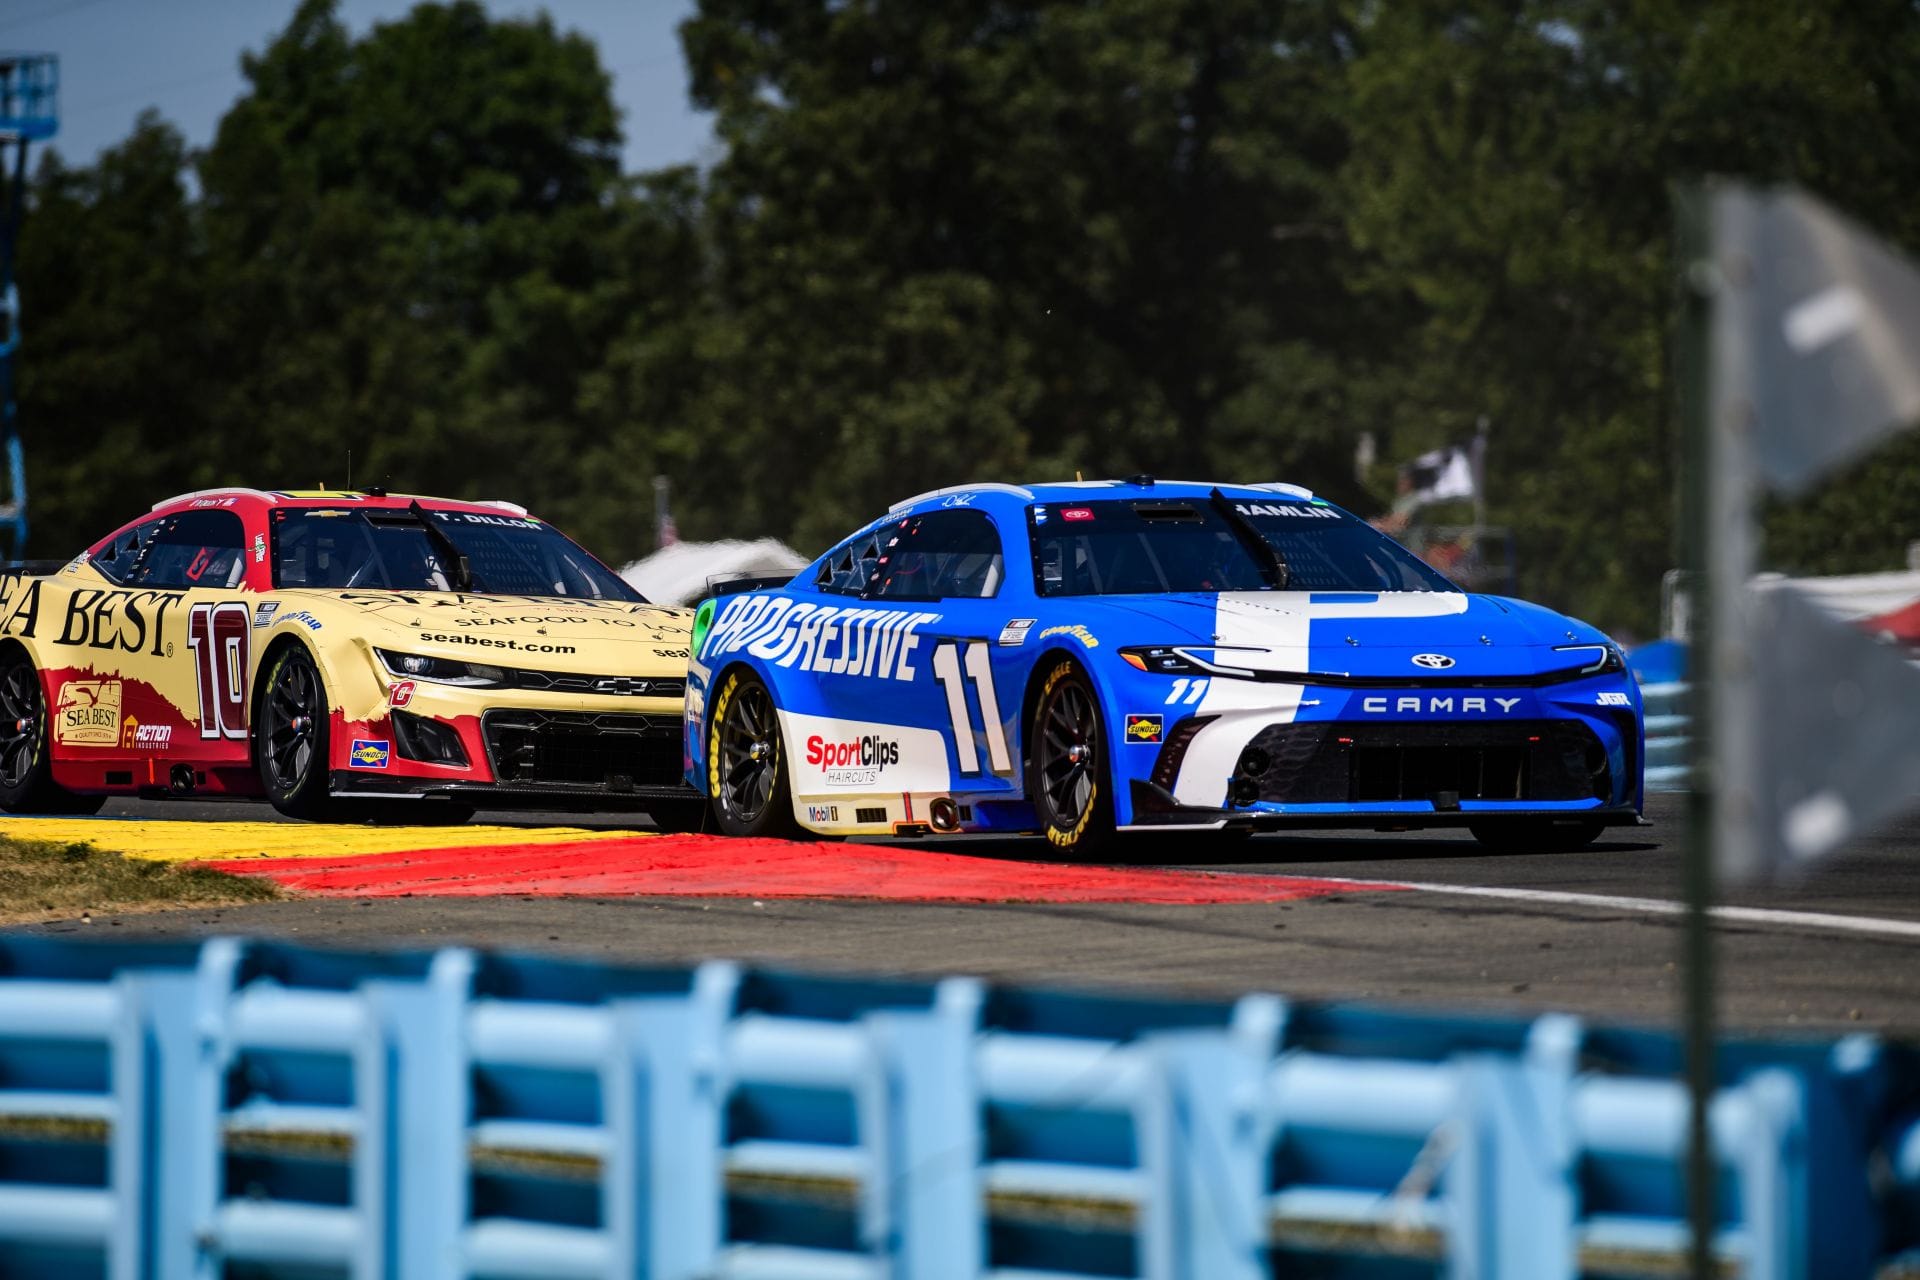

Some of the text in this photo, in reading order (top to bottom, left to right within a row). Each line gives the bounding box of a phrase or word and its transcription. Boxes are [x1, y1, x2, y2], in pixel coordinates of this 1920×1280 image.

[434, 512, 543, 531] T. DILLON
[454, 616, 588, 627] SEAFOOD
[593, 617, 636, 627] TO
[420, 632, 576, 654] seabest.com
[700, 595, 941, 682] PROGRESSIVE
[187, 602, 251, 741] 10
[1164, 678, 1209, 705] 11
[932, 642, 1012, 773] 11
[1363, 697, 1521, 713] CAMRY
[66, 708, 116, 728] SEA BEST
[136, 725, 172, 742] ACTION
[1129, 725, 1161, 734] SUNOCO
[136, 742, 169, 750] INDUSTRIES
[354, 750, 387, 760] SUNOCO
[806, 735, 899, 772] SportClips
[828, 771, 876, 783] HAIRCUTS
[809, 806, 830, 822] Mobil
